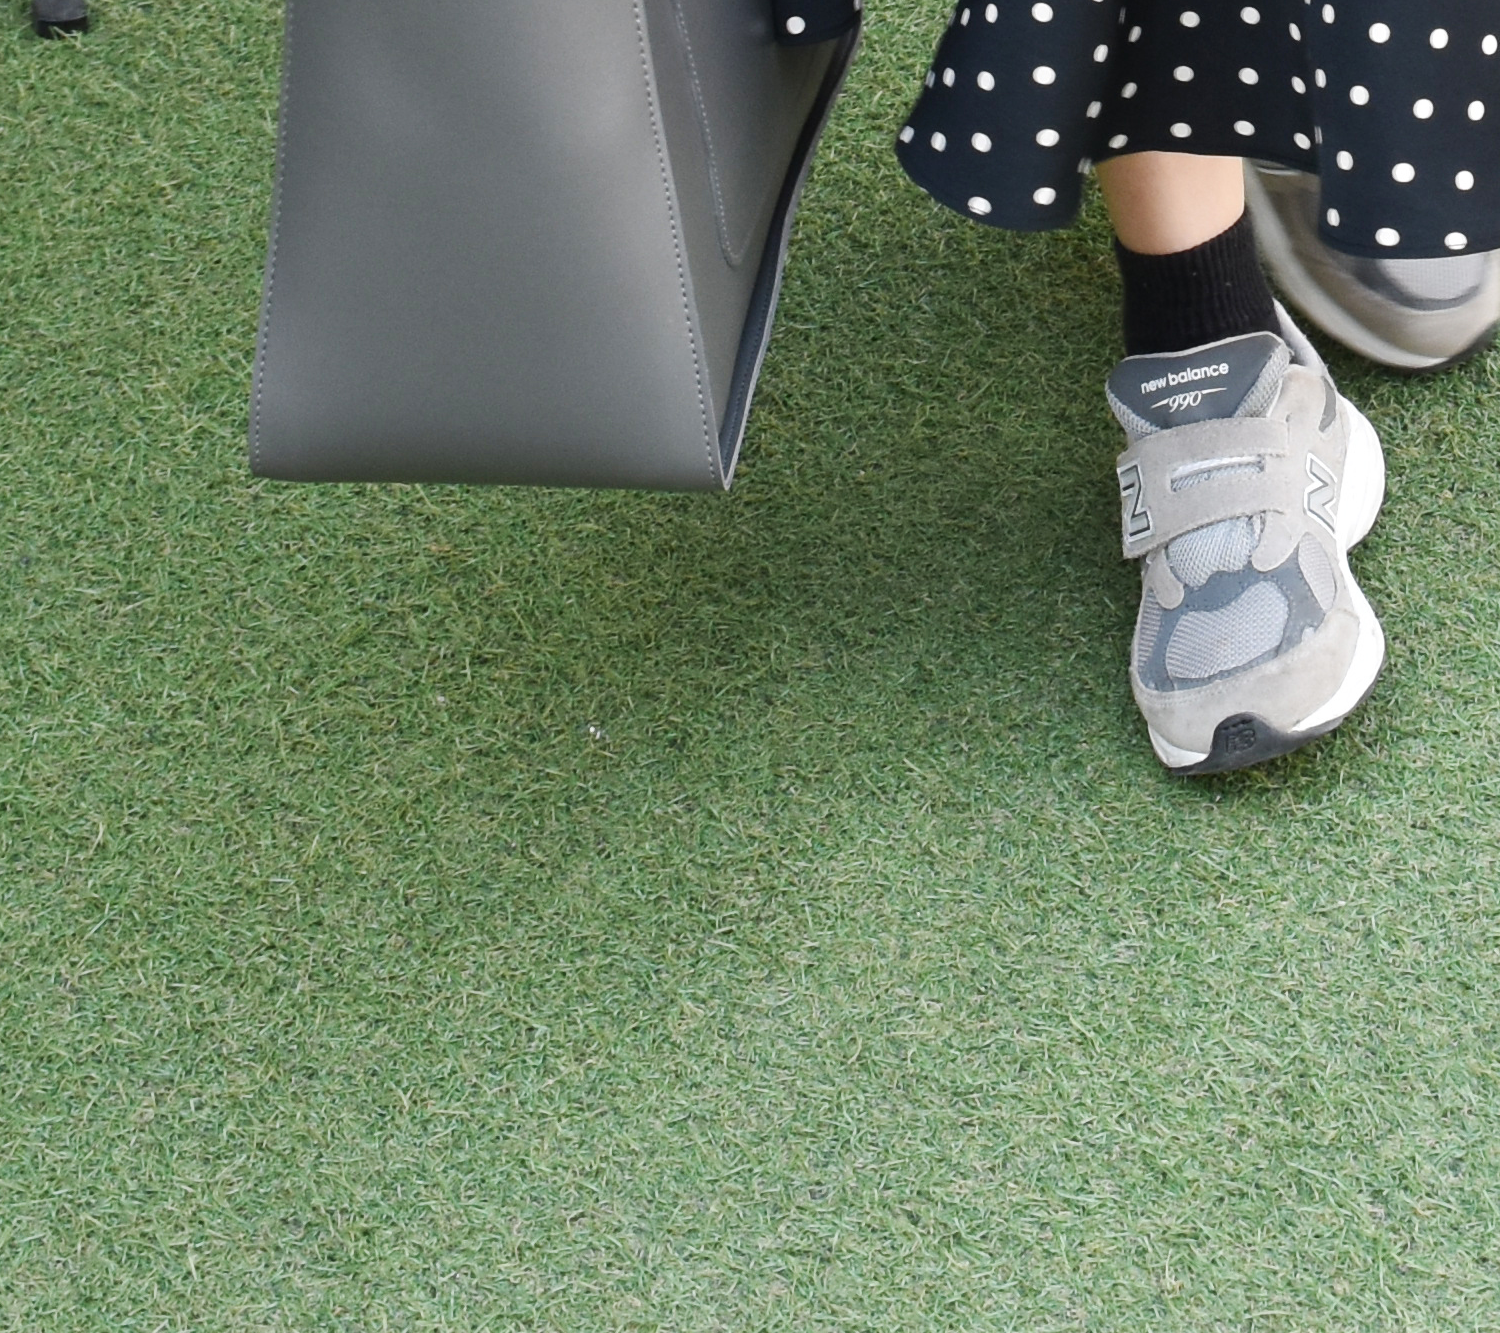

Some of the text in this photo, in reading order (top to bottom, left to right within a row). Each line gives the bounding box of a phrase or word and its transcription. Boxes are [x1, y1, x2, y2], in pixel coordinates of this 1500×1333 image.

[1141, 363, 1229, 394] new balance
[1169, 390, 1202, 413] 990
